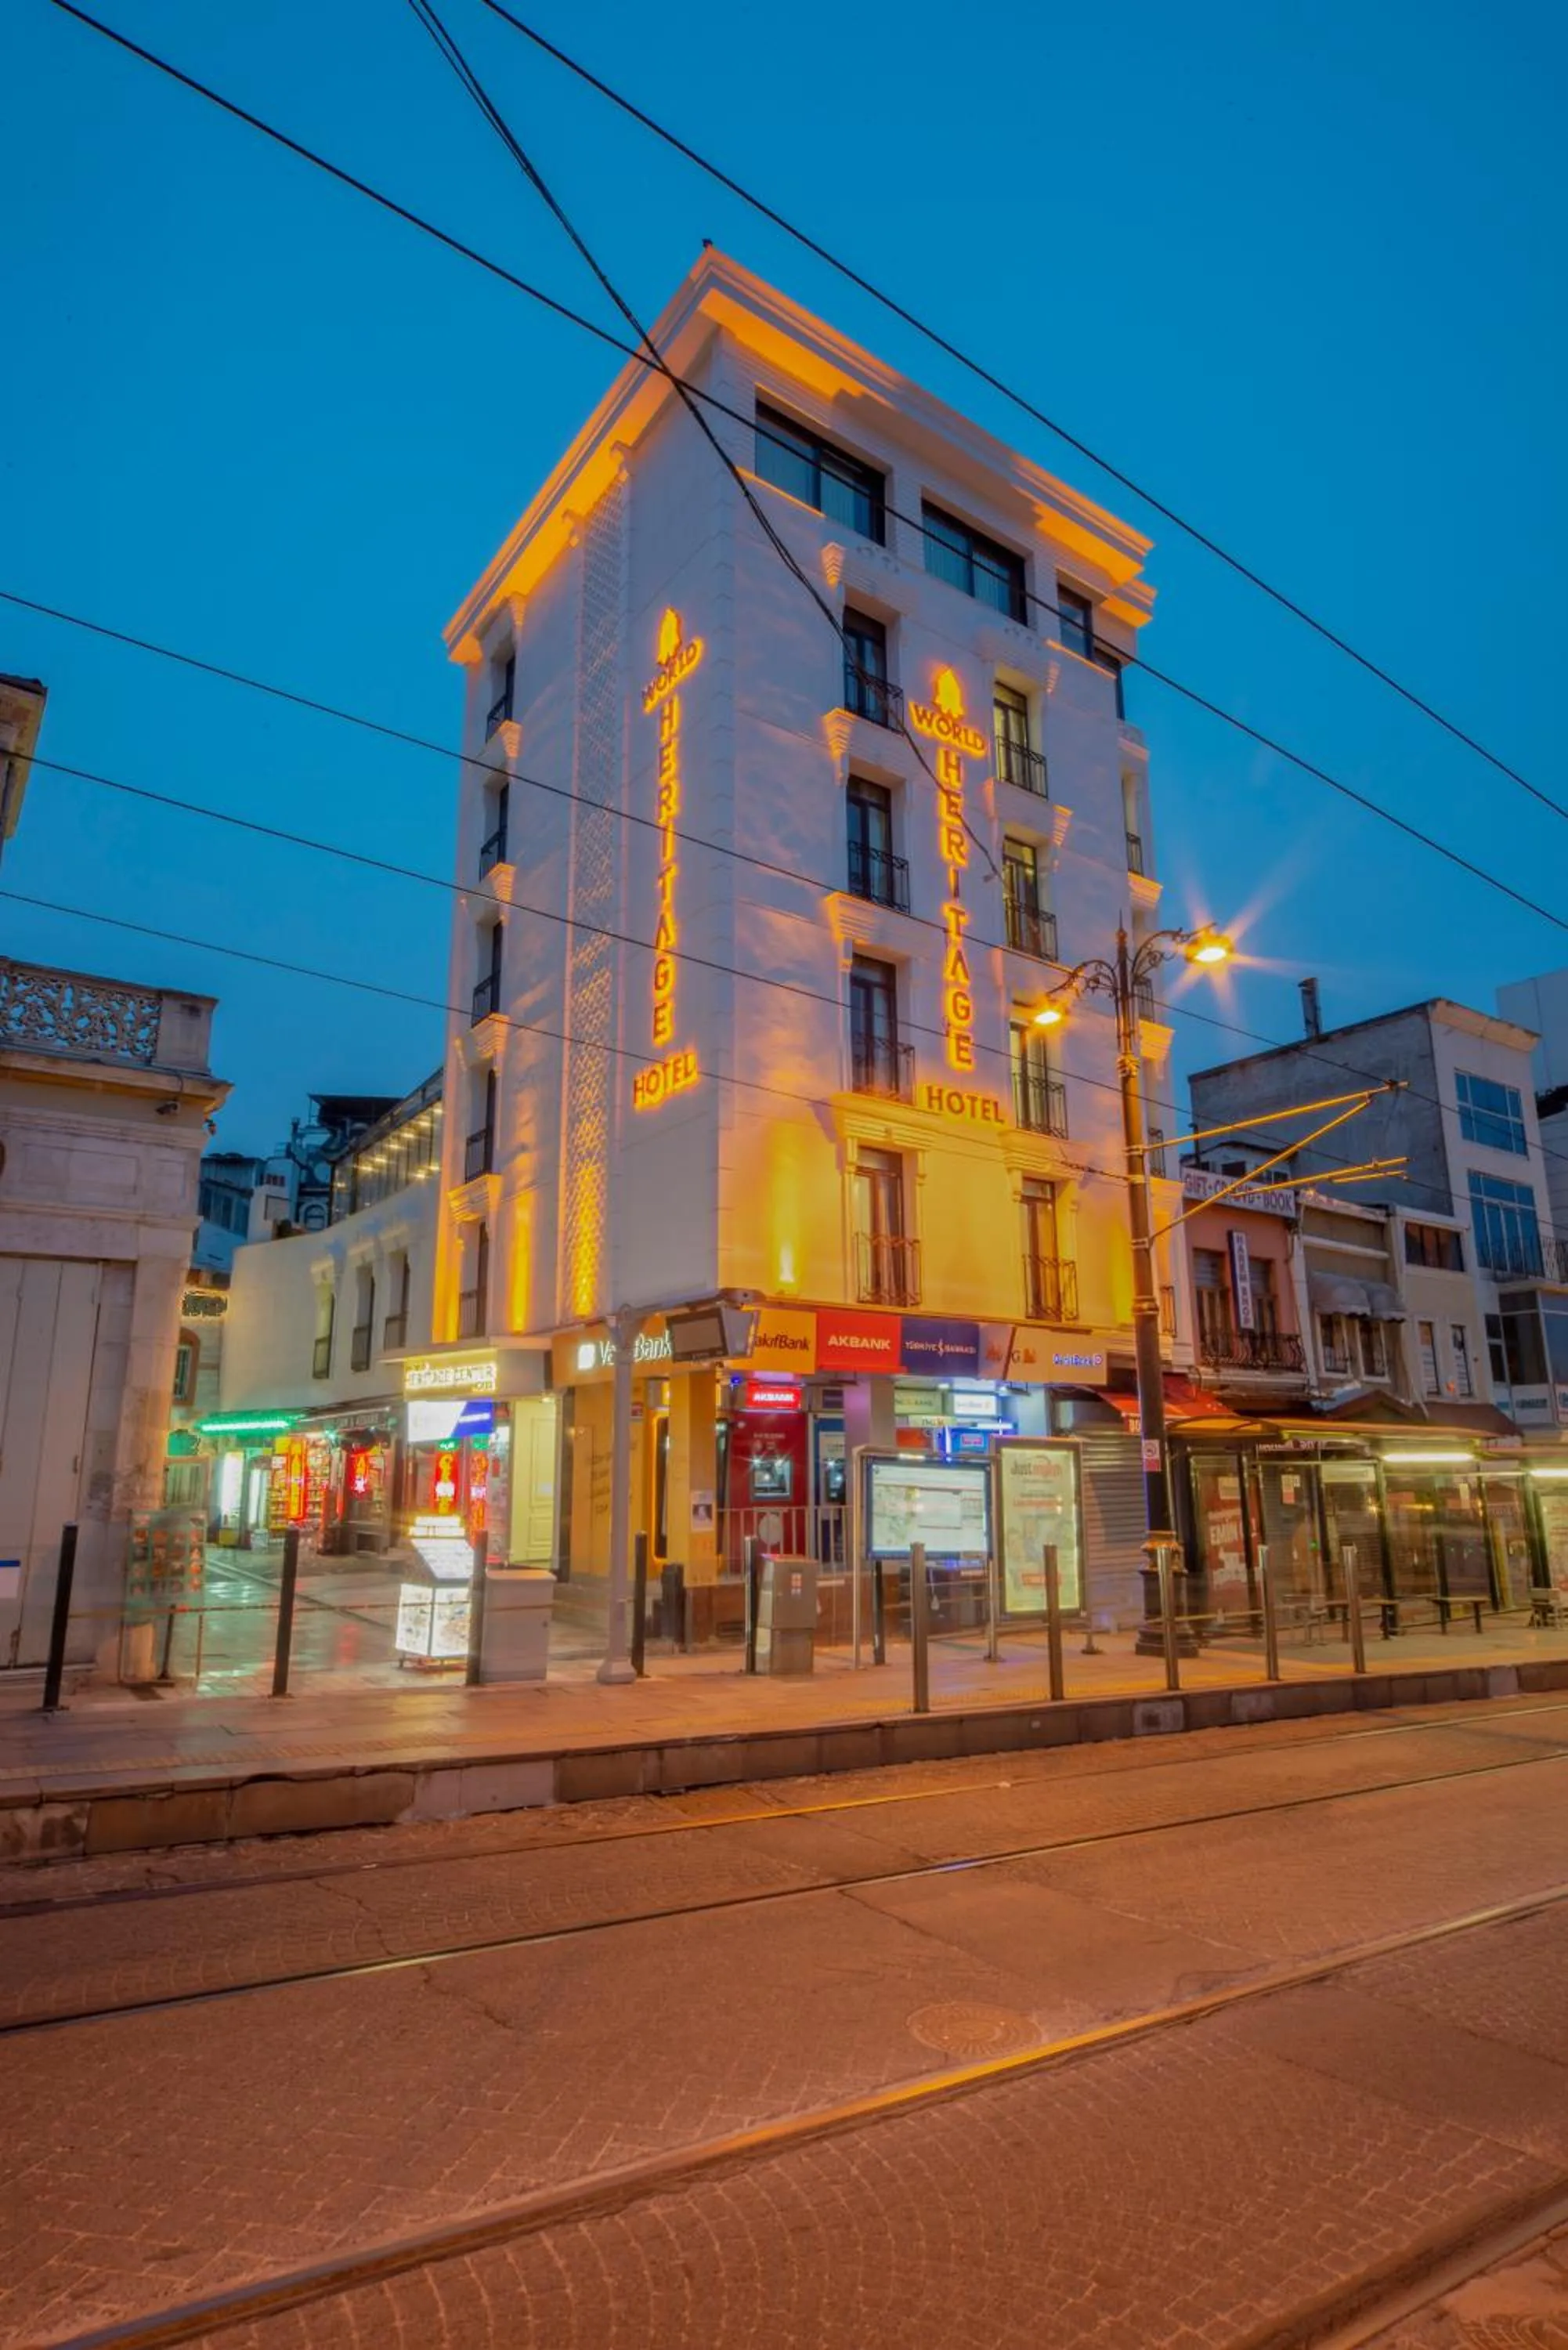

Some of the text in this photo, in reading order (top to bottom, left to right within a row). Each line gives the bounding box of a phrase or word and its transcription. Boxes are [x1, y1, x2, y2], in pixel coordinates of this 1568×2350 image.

[641, 641, 698, 703] WORLD
[913, 704, 985, 751] WORLD
[653, 700, 675, 1039] HERITAGE
[942, 750, 972, 1065] HERITAGE
[634, 1054, 694, 1104] HOTEL
[927, 1085, 1005, 1123] HOTEL
[1184, 1174, 1208, 1197] GIFT
[1263, 1191, 1293, 1213] BOOK
[827, 1334, 891, 1350] AKBANK
